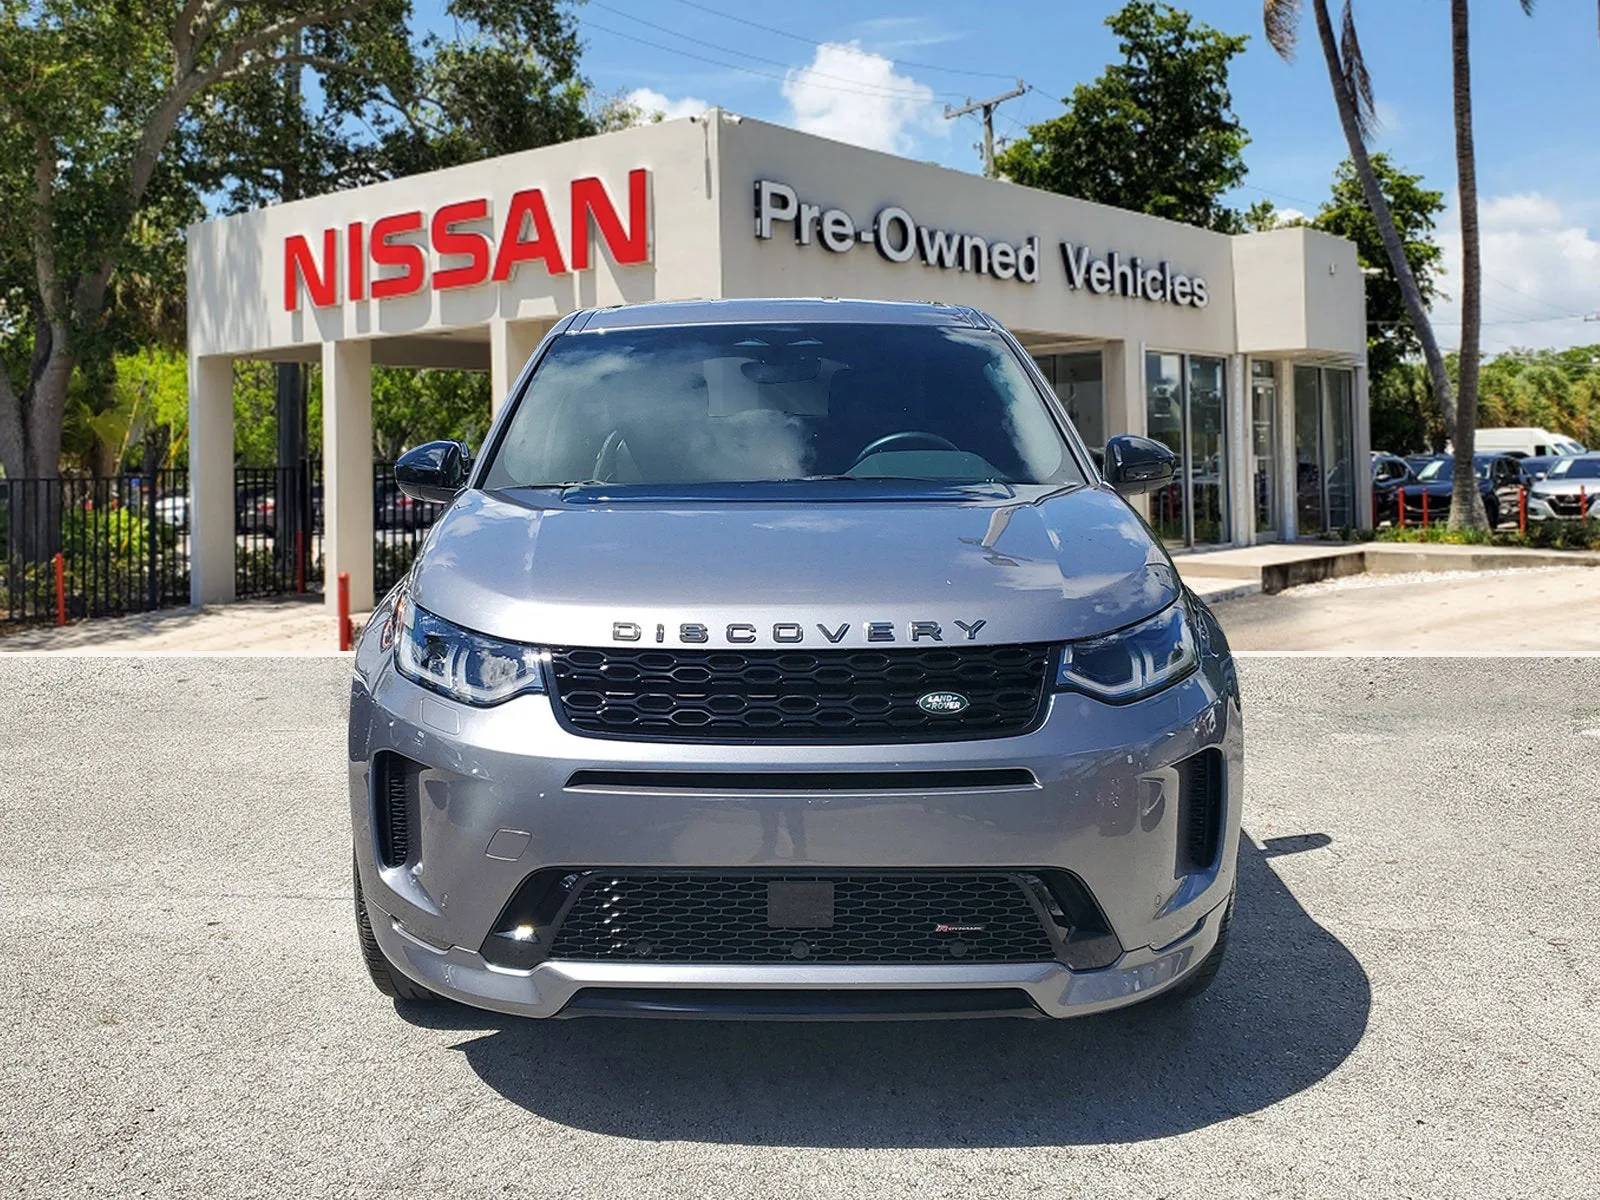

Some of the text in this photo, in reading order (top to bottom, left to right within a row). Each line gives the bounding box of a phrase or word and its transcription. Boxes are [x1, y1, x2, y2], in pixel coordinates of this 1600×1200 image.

[285, 169, 647, 312] NISSAN
[754, 180, 1208, 309] Pre-Owned Vehicles
[612, 619, 987, 644] DISCOVERY
[931, 701, 961, 709] ROVER
